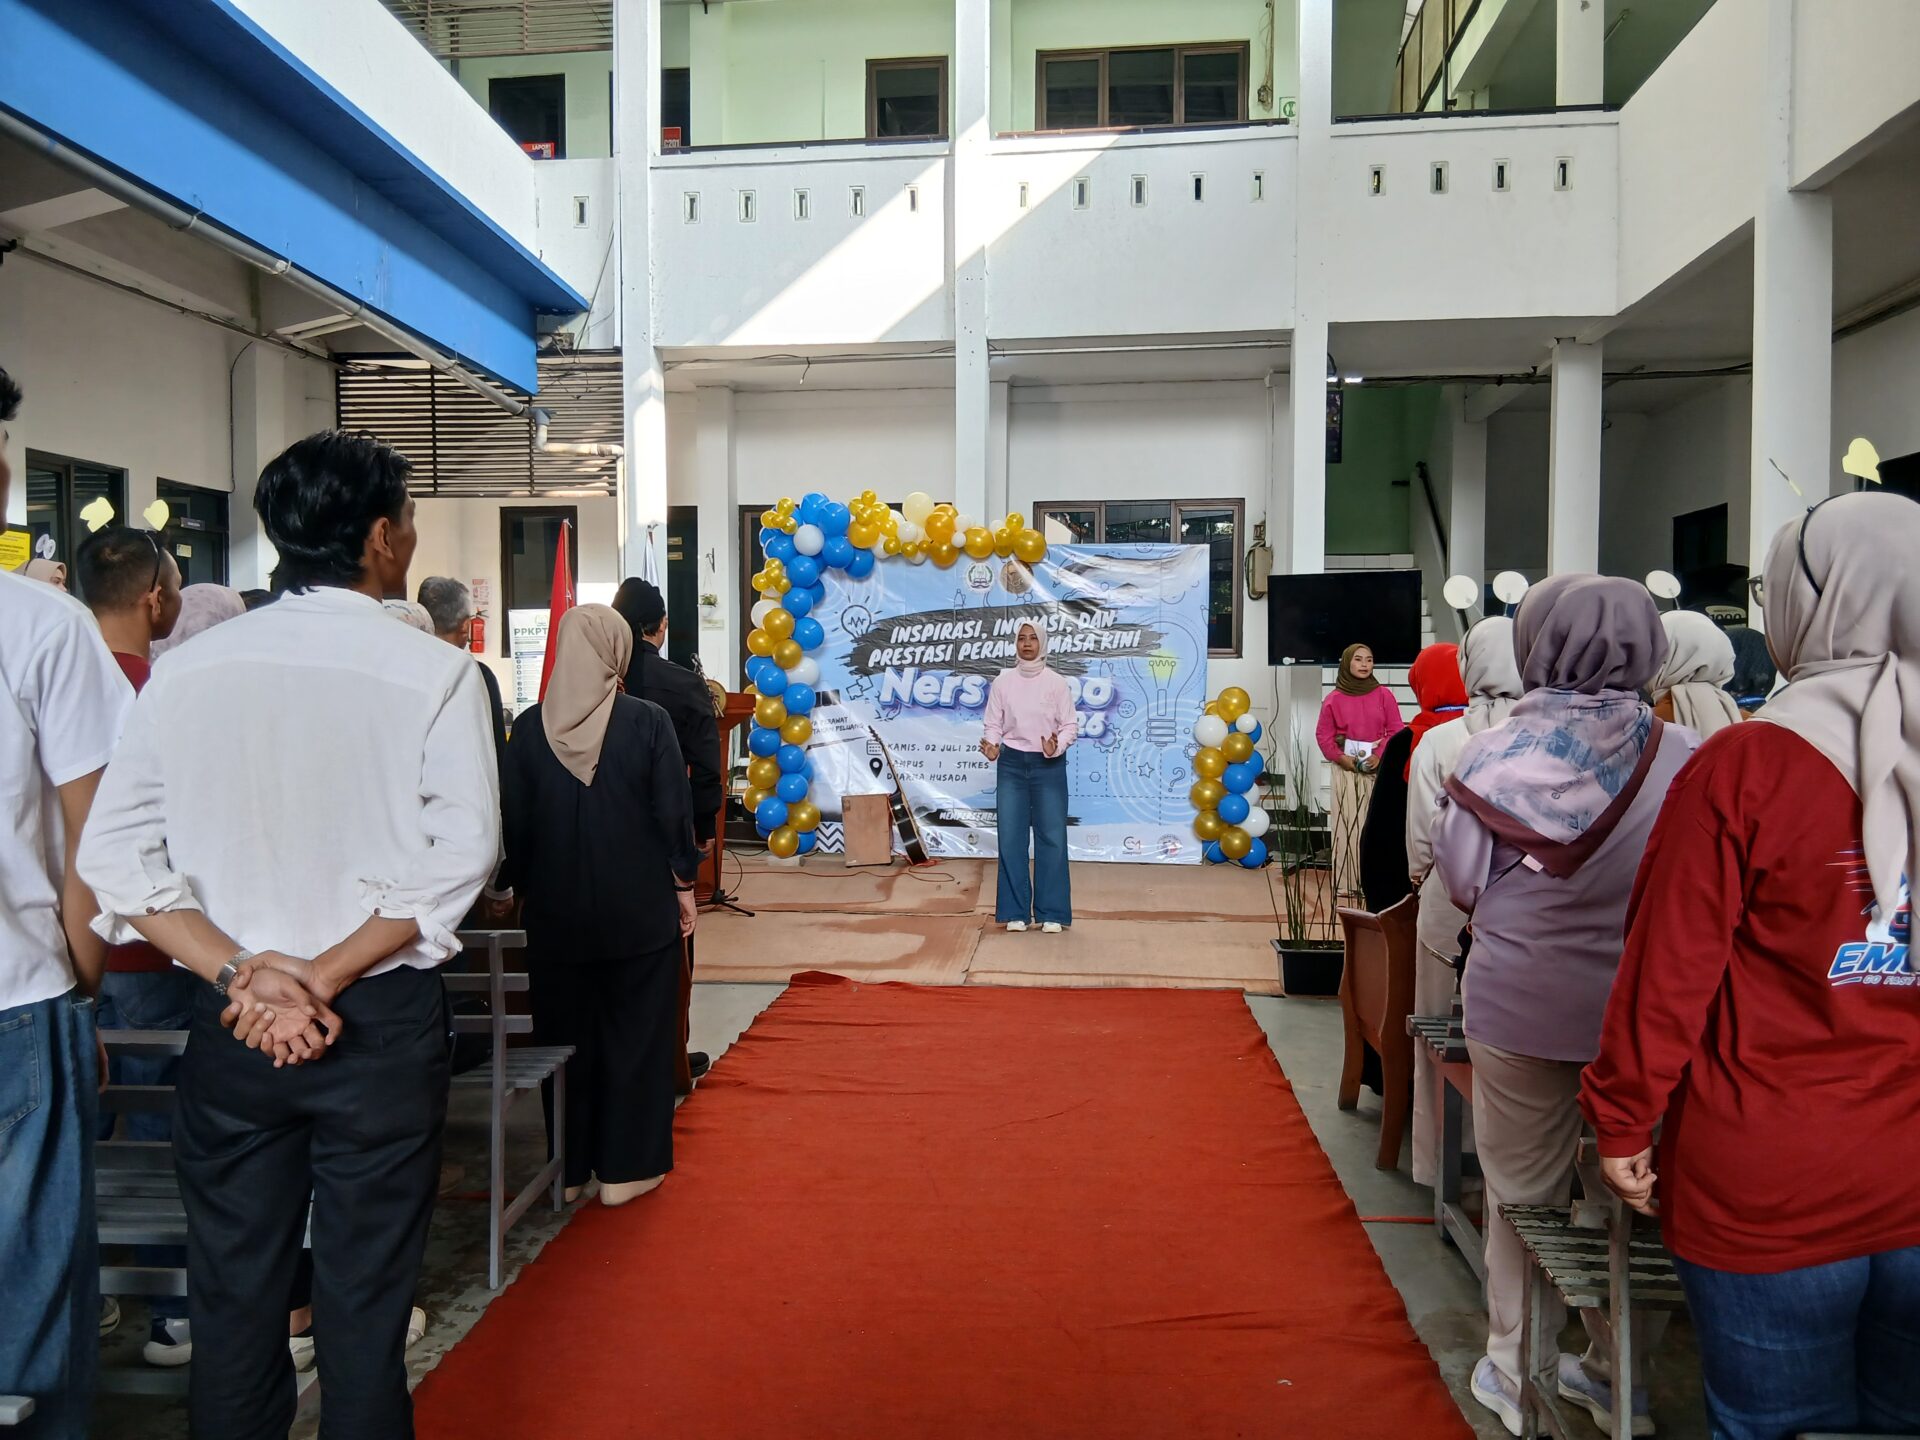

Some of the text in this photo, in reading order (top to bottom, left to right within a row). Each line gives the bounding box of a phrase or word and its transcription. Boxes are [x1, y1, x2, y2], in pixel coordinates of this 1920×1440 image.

[514, 627, 548, 636] PPKPT
[890, 620, 988, 644] INSPIRASI,
[1078, 610, 1116, 628] DAN
[867, 629, 1142, 668] PRESTASI PERAW MASA KINI
[879, 666, 988, 708] Ners
[1076, 711, 1108, 739] 26
[924, 744, 937, 752] 02
[940, 744, 961, 752] JULI
[965, 744, 982, 753] 202
[887, 760, 924, 768] AMPUS
[956, 761, 990, 770] STIKES
[929, 773, 968, 782] HUSADA
[1827, 942, 1913, 978] EM
